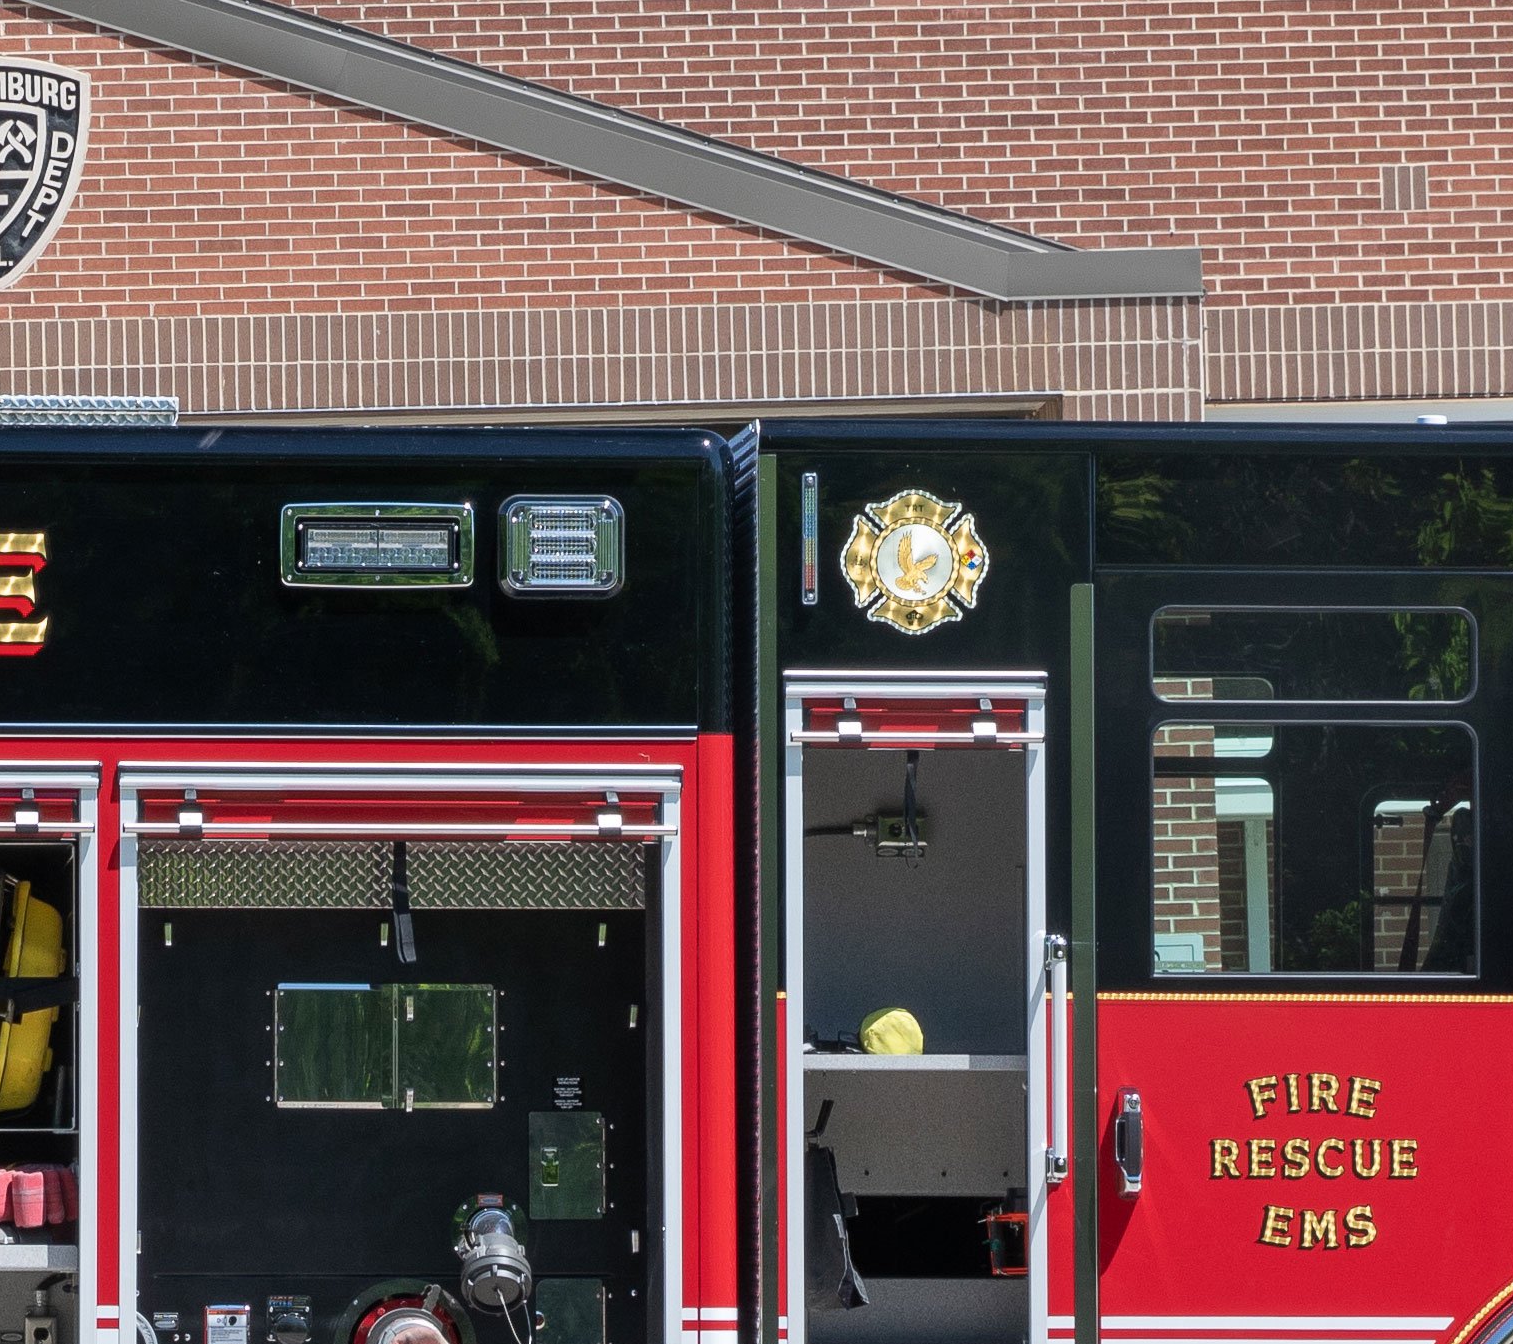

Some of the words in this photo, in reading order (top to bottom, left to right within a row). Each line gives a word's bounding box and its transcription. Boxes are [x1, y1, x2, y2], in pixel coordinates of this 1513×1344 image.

[21, 131, 75, 238] DEPT
[1245, 1072, 1383, 1121] FIRE
[1209, 1138, 1419, 1179] RESCUE
[1255, 1204, 1377, 1250] EMS
